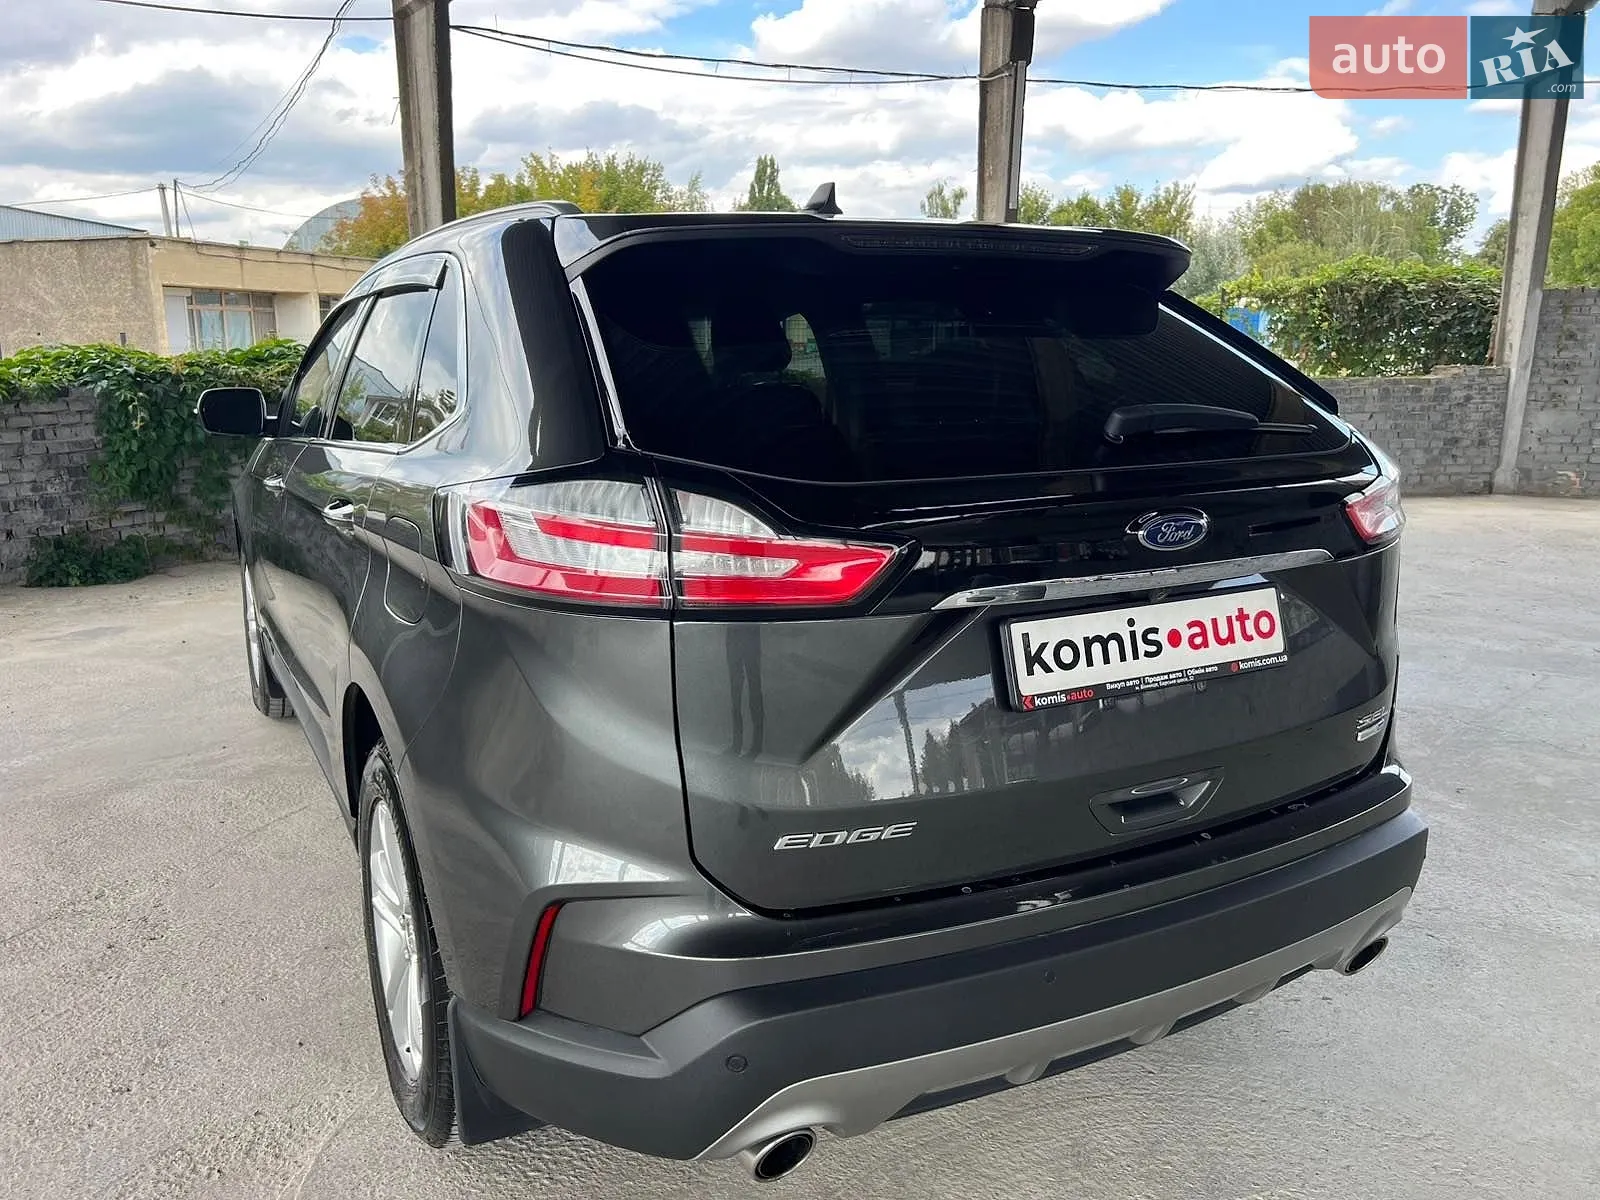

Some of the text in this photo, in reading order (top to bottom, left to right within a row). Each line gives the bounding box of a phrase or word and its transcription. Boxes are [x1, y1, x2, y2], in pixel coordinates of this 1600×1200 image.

[1157, 522, 1196, 543] Ford
[1238, 654, 1288, 670] komis.com.ua
[773, 821, 919, 851] EDGE
